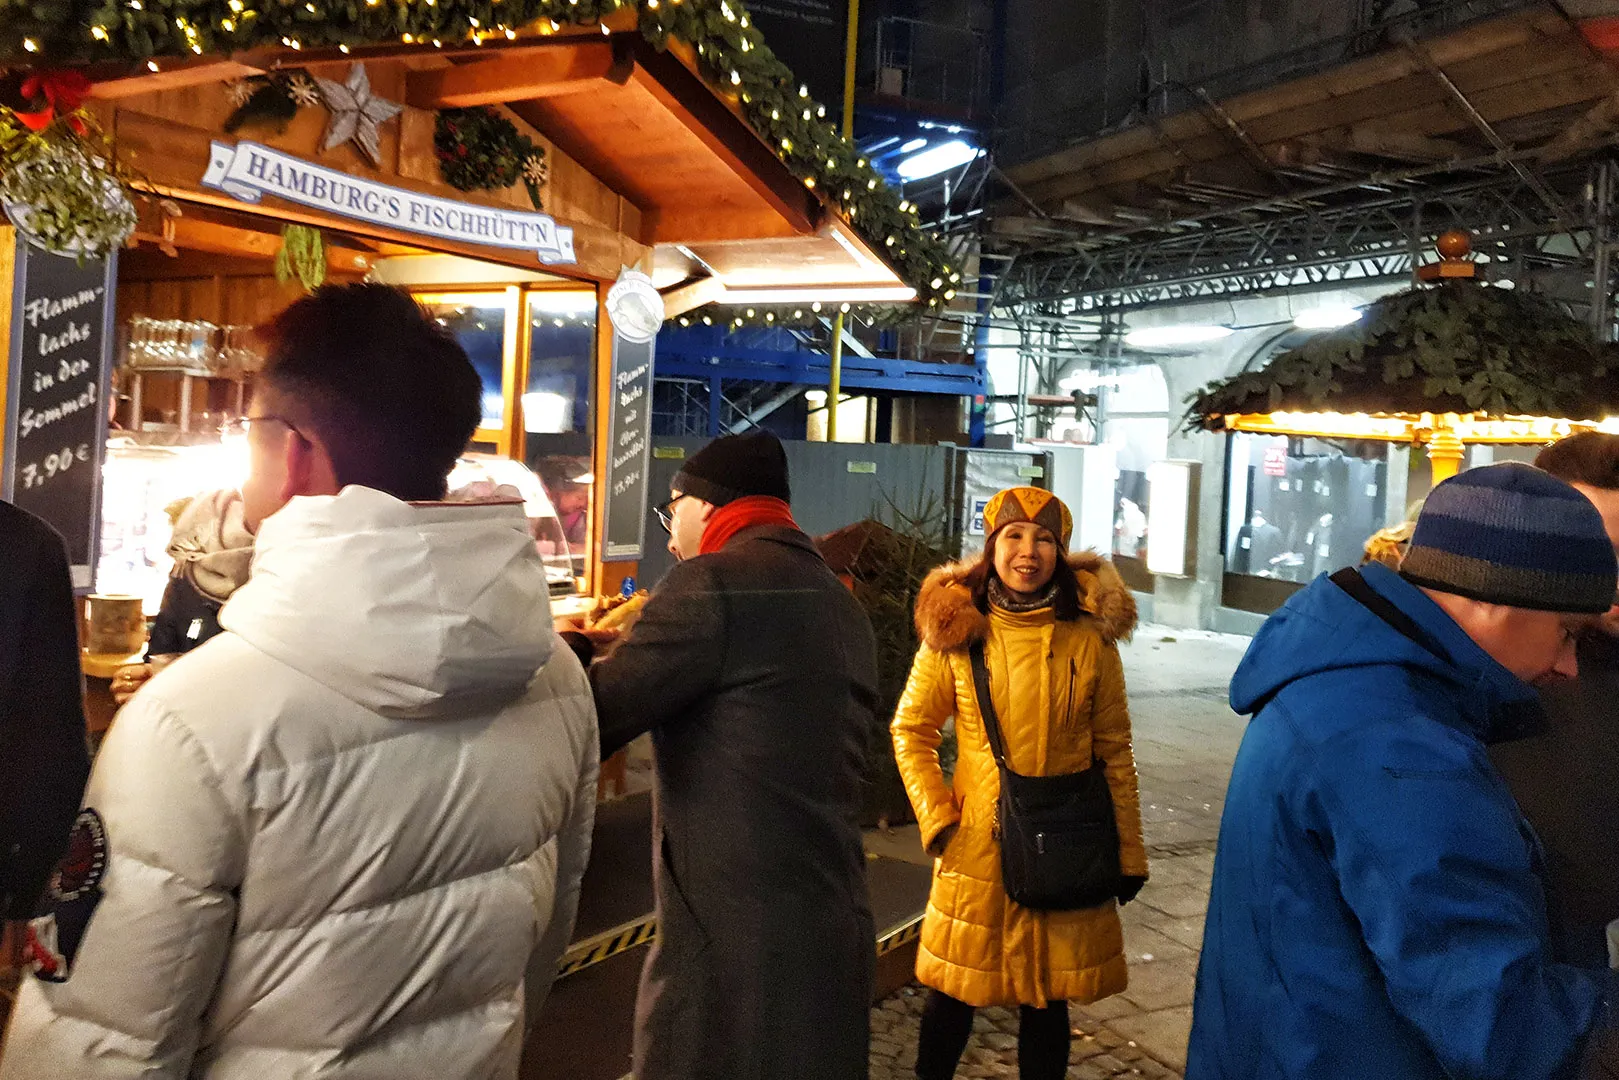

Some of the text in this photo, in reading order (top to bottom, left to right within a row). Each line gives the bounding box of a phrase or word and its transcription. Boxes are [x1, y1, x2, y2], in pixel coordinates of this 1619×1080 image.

[247, 152, 548, 243] HAMBURG'S FISCHHÜTT'N
[24, 287, 103, 327] Flamm-
[33, 358, 90, 393] in der
